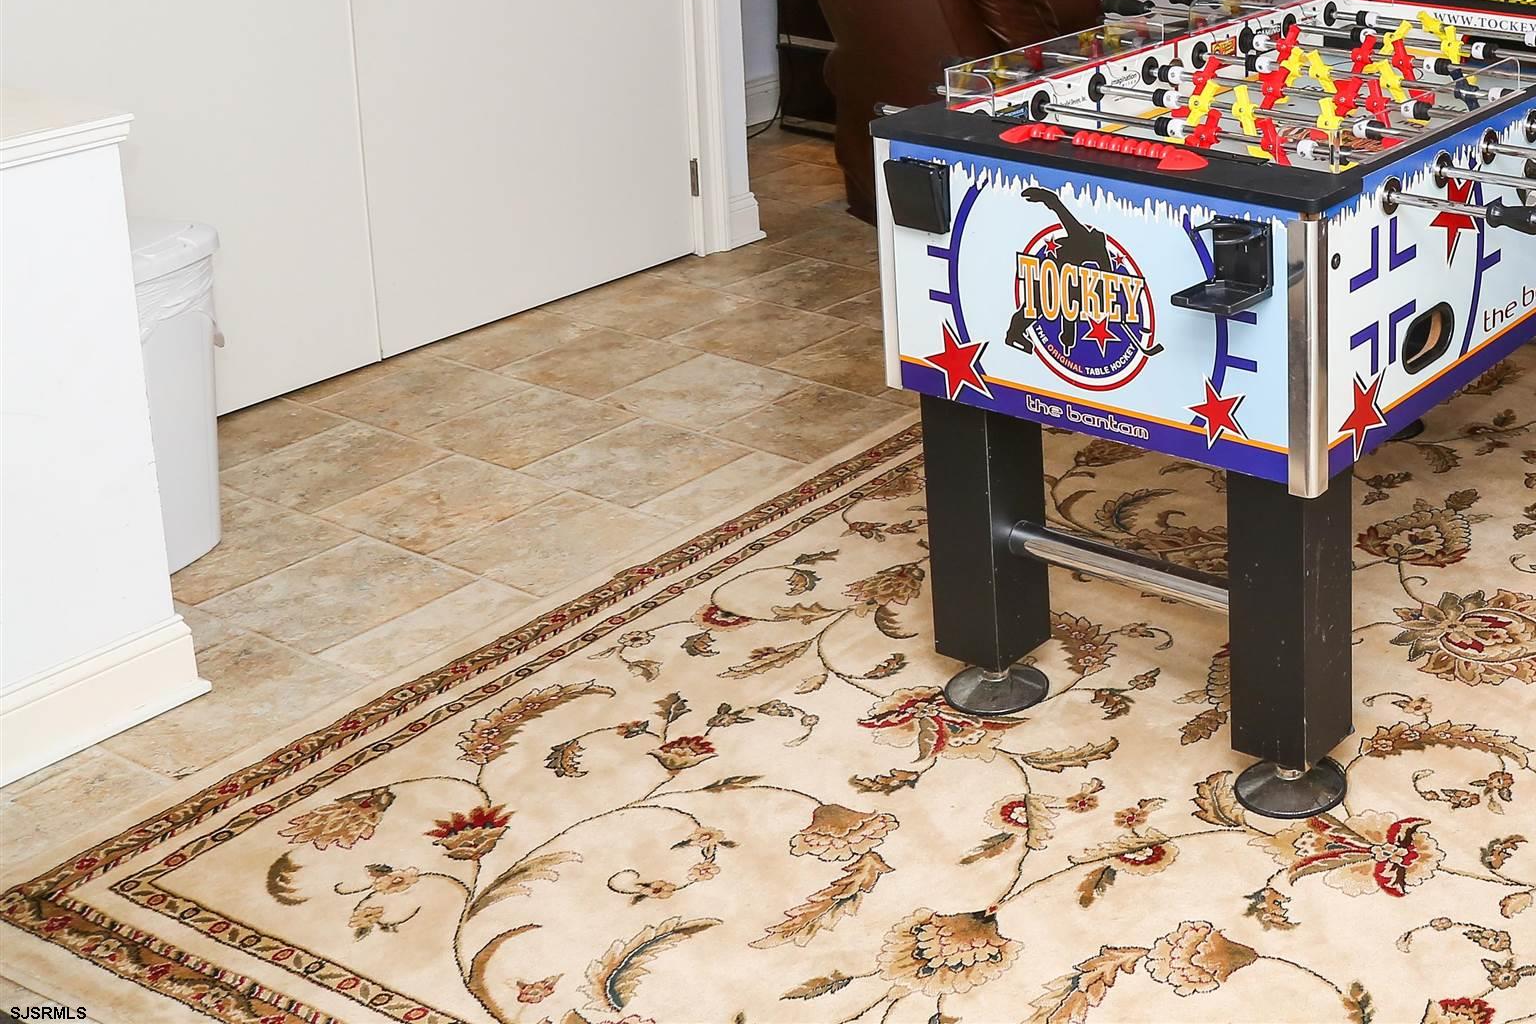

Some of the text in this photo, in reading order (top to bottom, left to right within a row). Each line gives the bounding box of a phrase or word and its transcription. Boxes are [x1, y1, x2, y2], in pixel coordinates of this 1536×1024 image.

[1017, 254, 1145, 323] TOCKEY
[1483, 301, 1518, 333] the
[1035, 325, 1136, 376] THE ORIGINAL TABLE HOCKEY
[1026, 394, 1149, 440] the bantam
